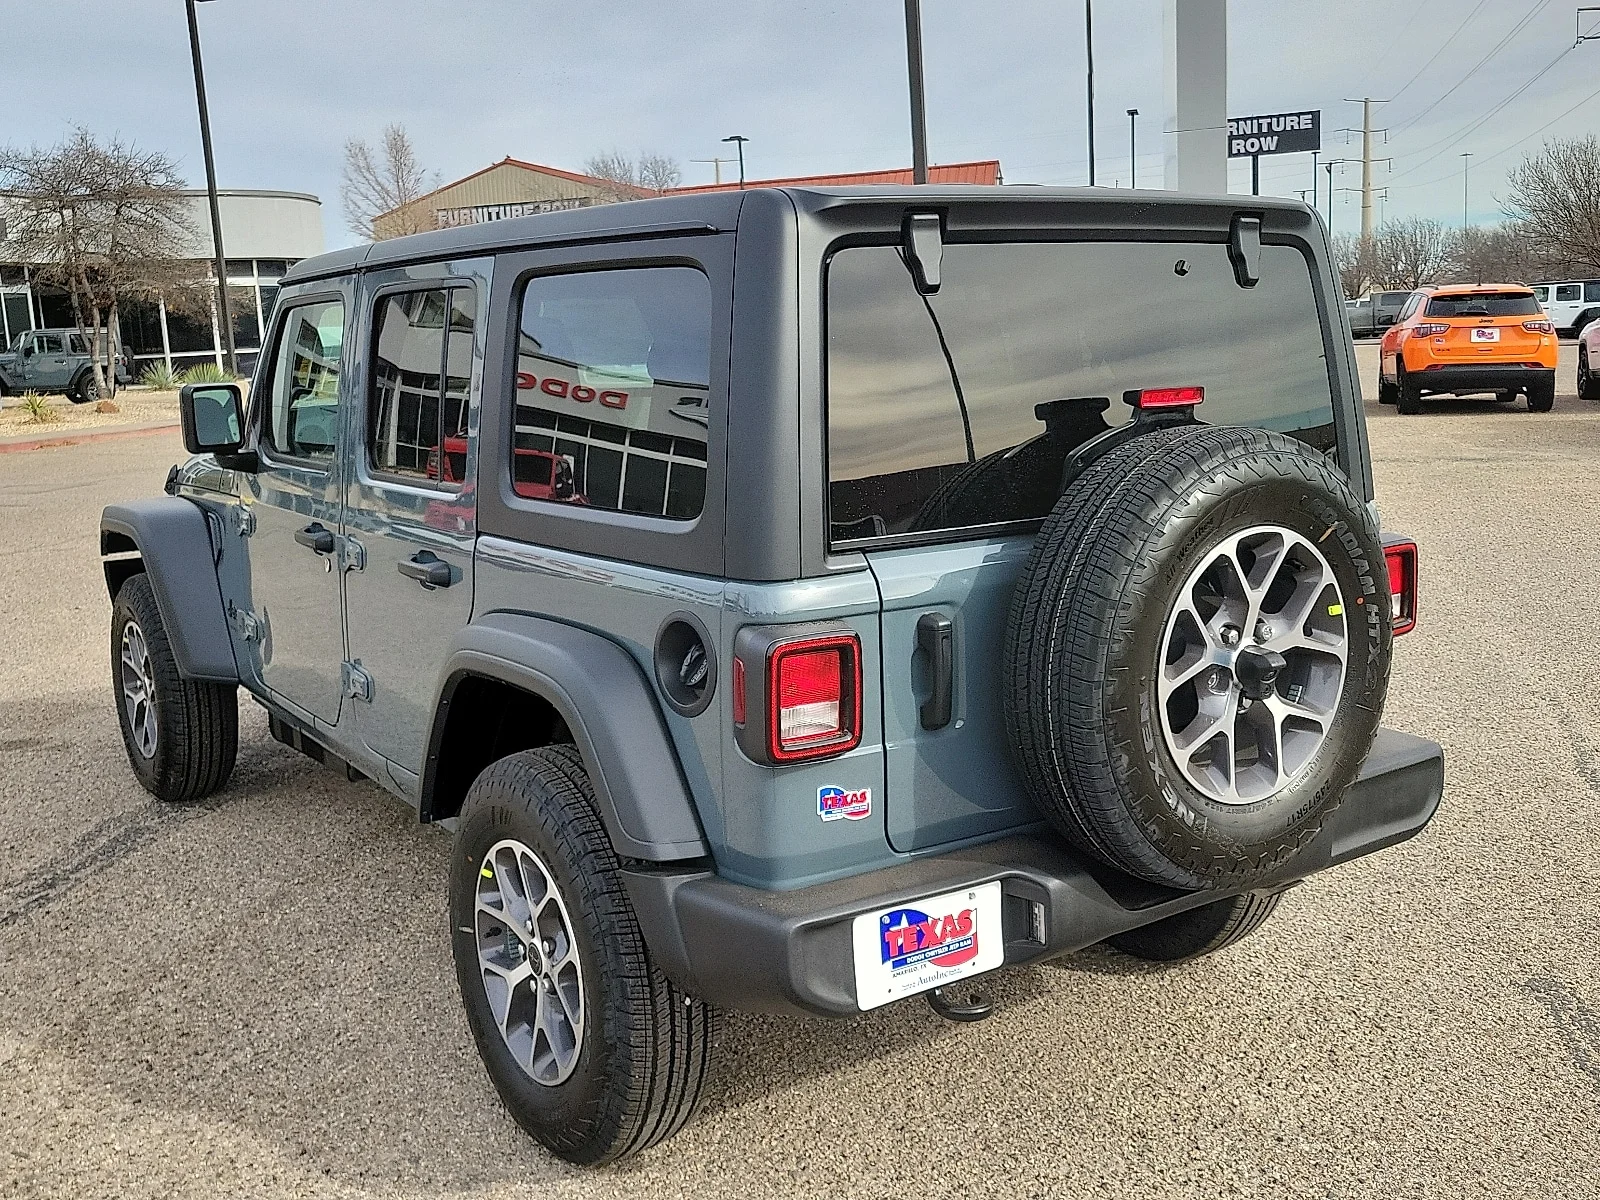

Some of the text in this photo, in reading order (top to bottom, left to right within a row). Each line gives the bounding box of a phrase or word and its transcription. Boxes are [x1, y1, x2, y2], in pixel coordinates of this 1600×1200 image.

[1227, 114, 1313, 136] RNITURE
[1231, 136, 1279, 154] ROW
[1139, 689, 1195, 828] NEXEN
[822, 790, 867, 810] TEXAS
[885, 909, 973, 957] TEXAS
